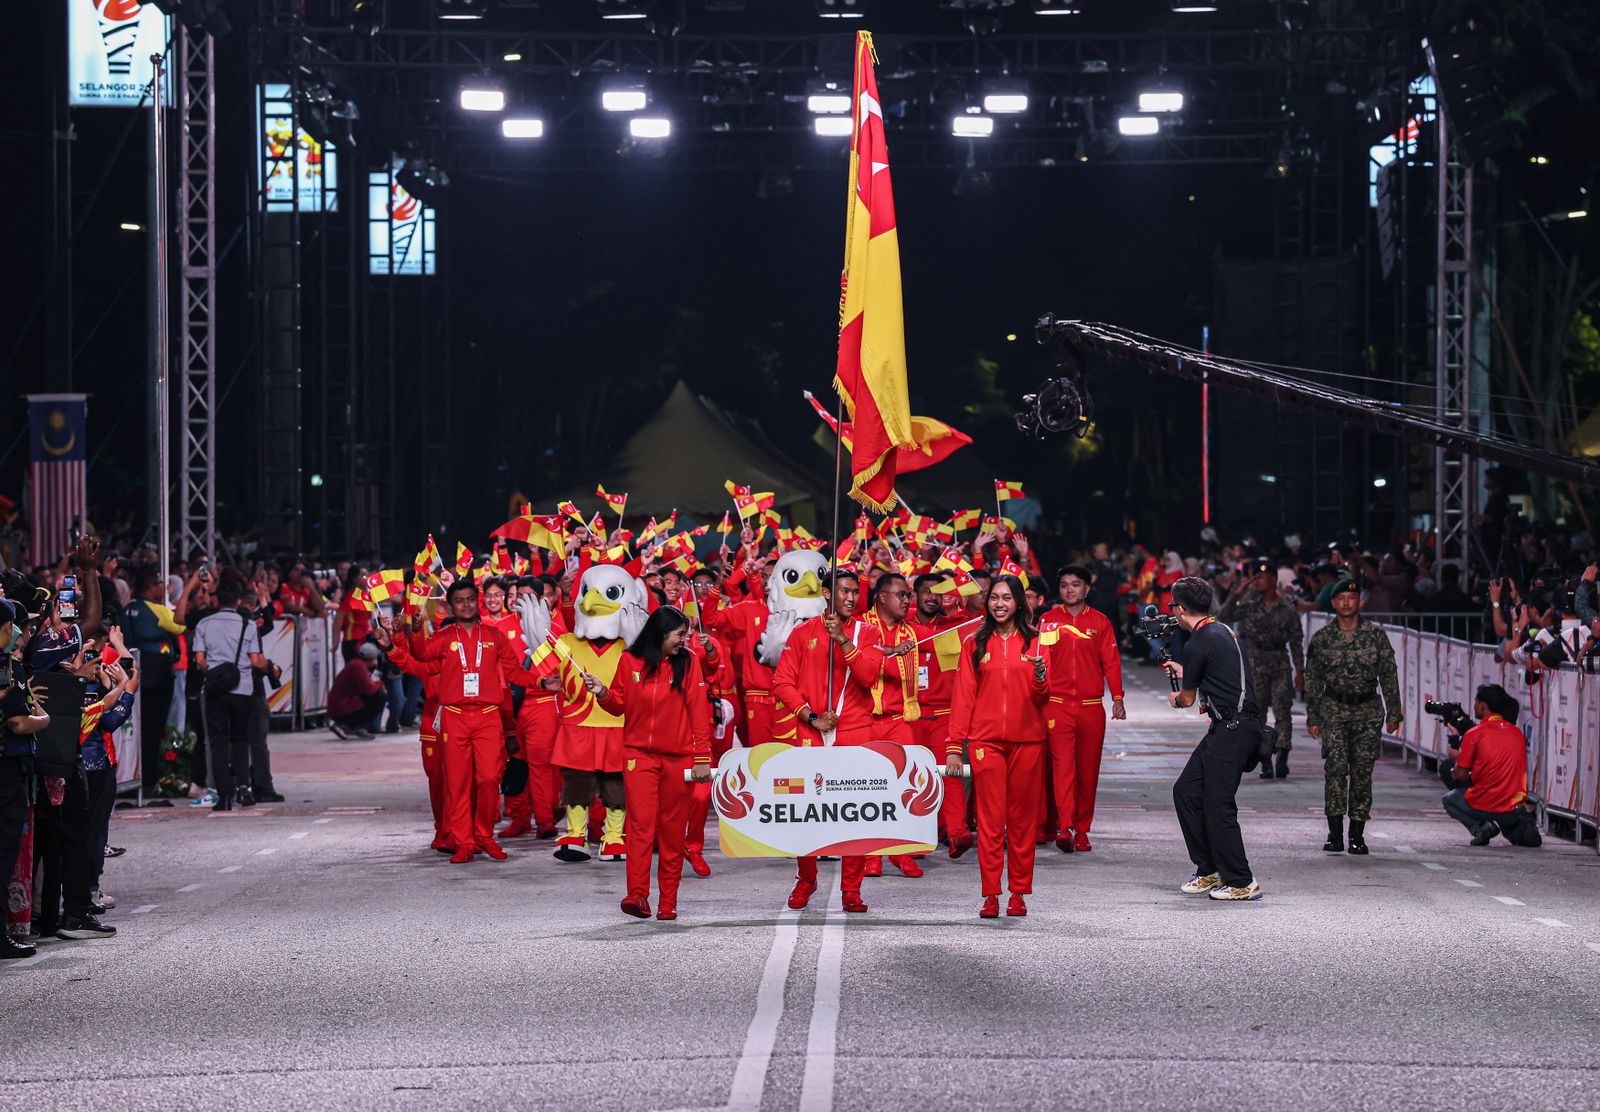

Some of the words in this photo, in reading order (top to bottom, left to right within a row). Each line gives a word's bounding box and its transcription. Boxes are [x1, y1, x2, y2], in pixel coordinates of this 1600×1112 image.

[79, 83, 136, 91] SELANGOR
[869, 778, 888, 786] 2026
[759, 802, 897, 823] SELANGOR
